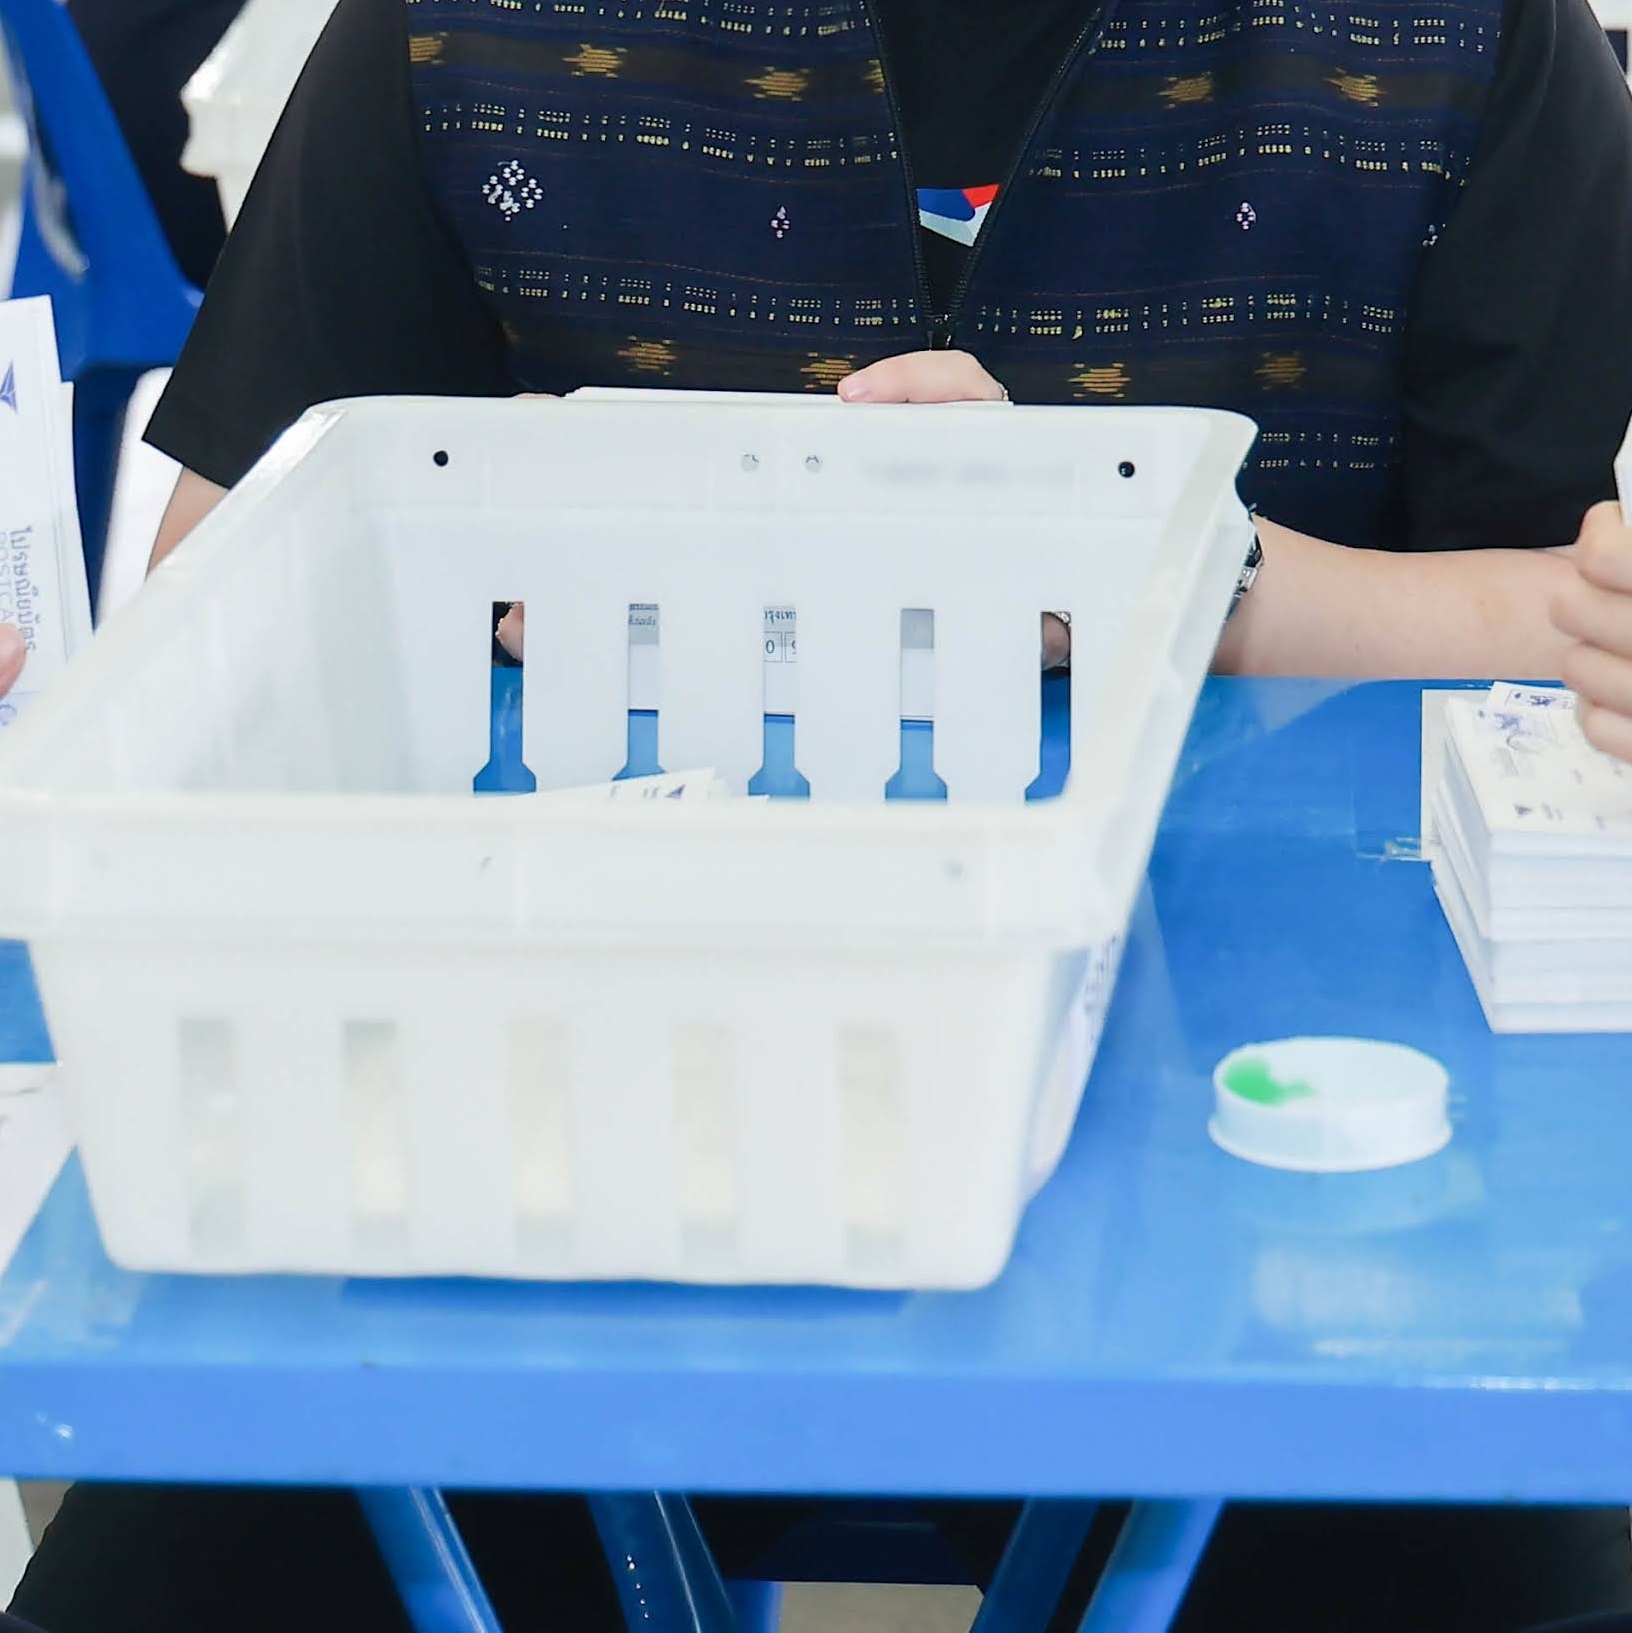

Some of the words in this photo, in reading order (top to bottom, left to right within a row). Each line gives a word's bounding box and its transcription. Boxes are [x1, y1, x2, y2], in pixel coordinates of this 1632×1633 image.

[11, 526, 41, 652] ไปรษณียบัตร
